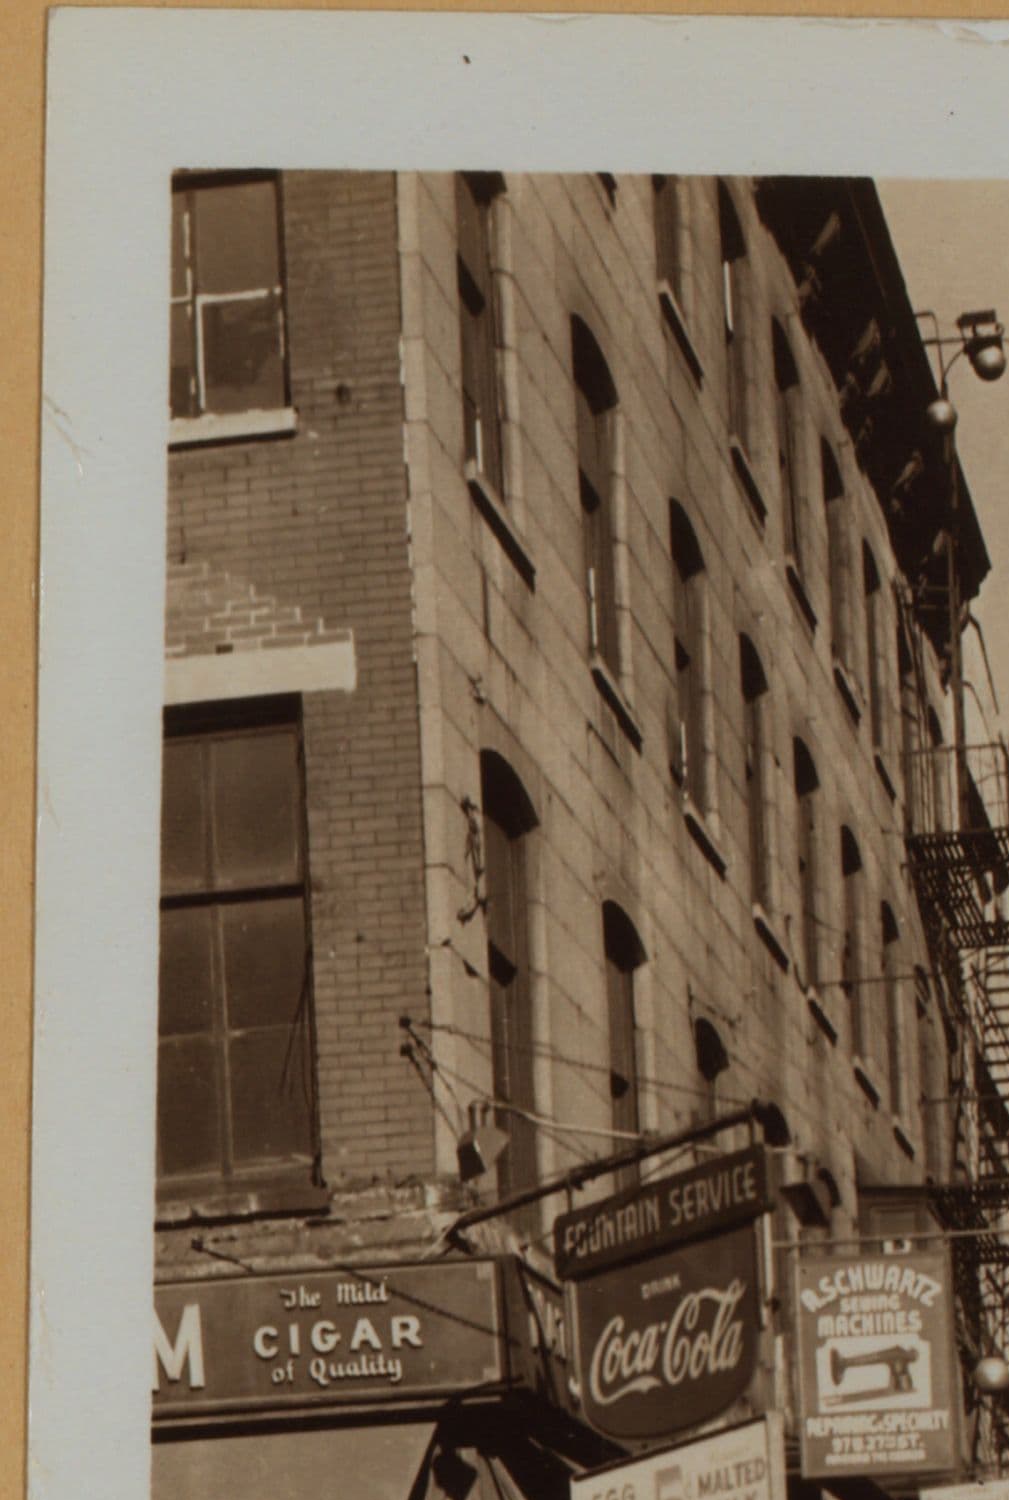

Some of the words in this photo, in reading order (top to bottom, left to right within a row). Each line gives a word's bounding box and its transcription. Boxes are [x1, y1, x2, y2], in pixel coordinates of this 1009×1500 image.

[564, 1194, 661, 1258] FOUNTAIN
[668, 1161, 758, 1227] SERVICE
[279, 1285, 321, 1310] The
[336, 1276, 390, 1304] Mild
[253, 1314, 424, 1359] CIGAR
[590, 1277, 748, 1405] Coca-Cola
[816, 1310, 922, 1338] MACHINES
[271, 1358, 295, 1383] of
[309, 1353, 403, 1386] Quality
[697, 1457, 767, 1499] MALTED
